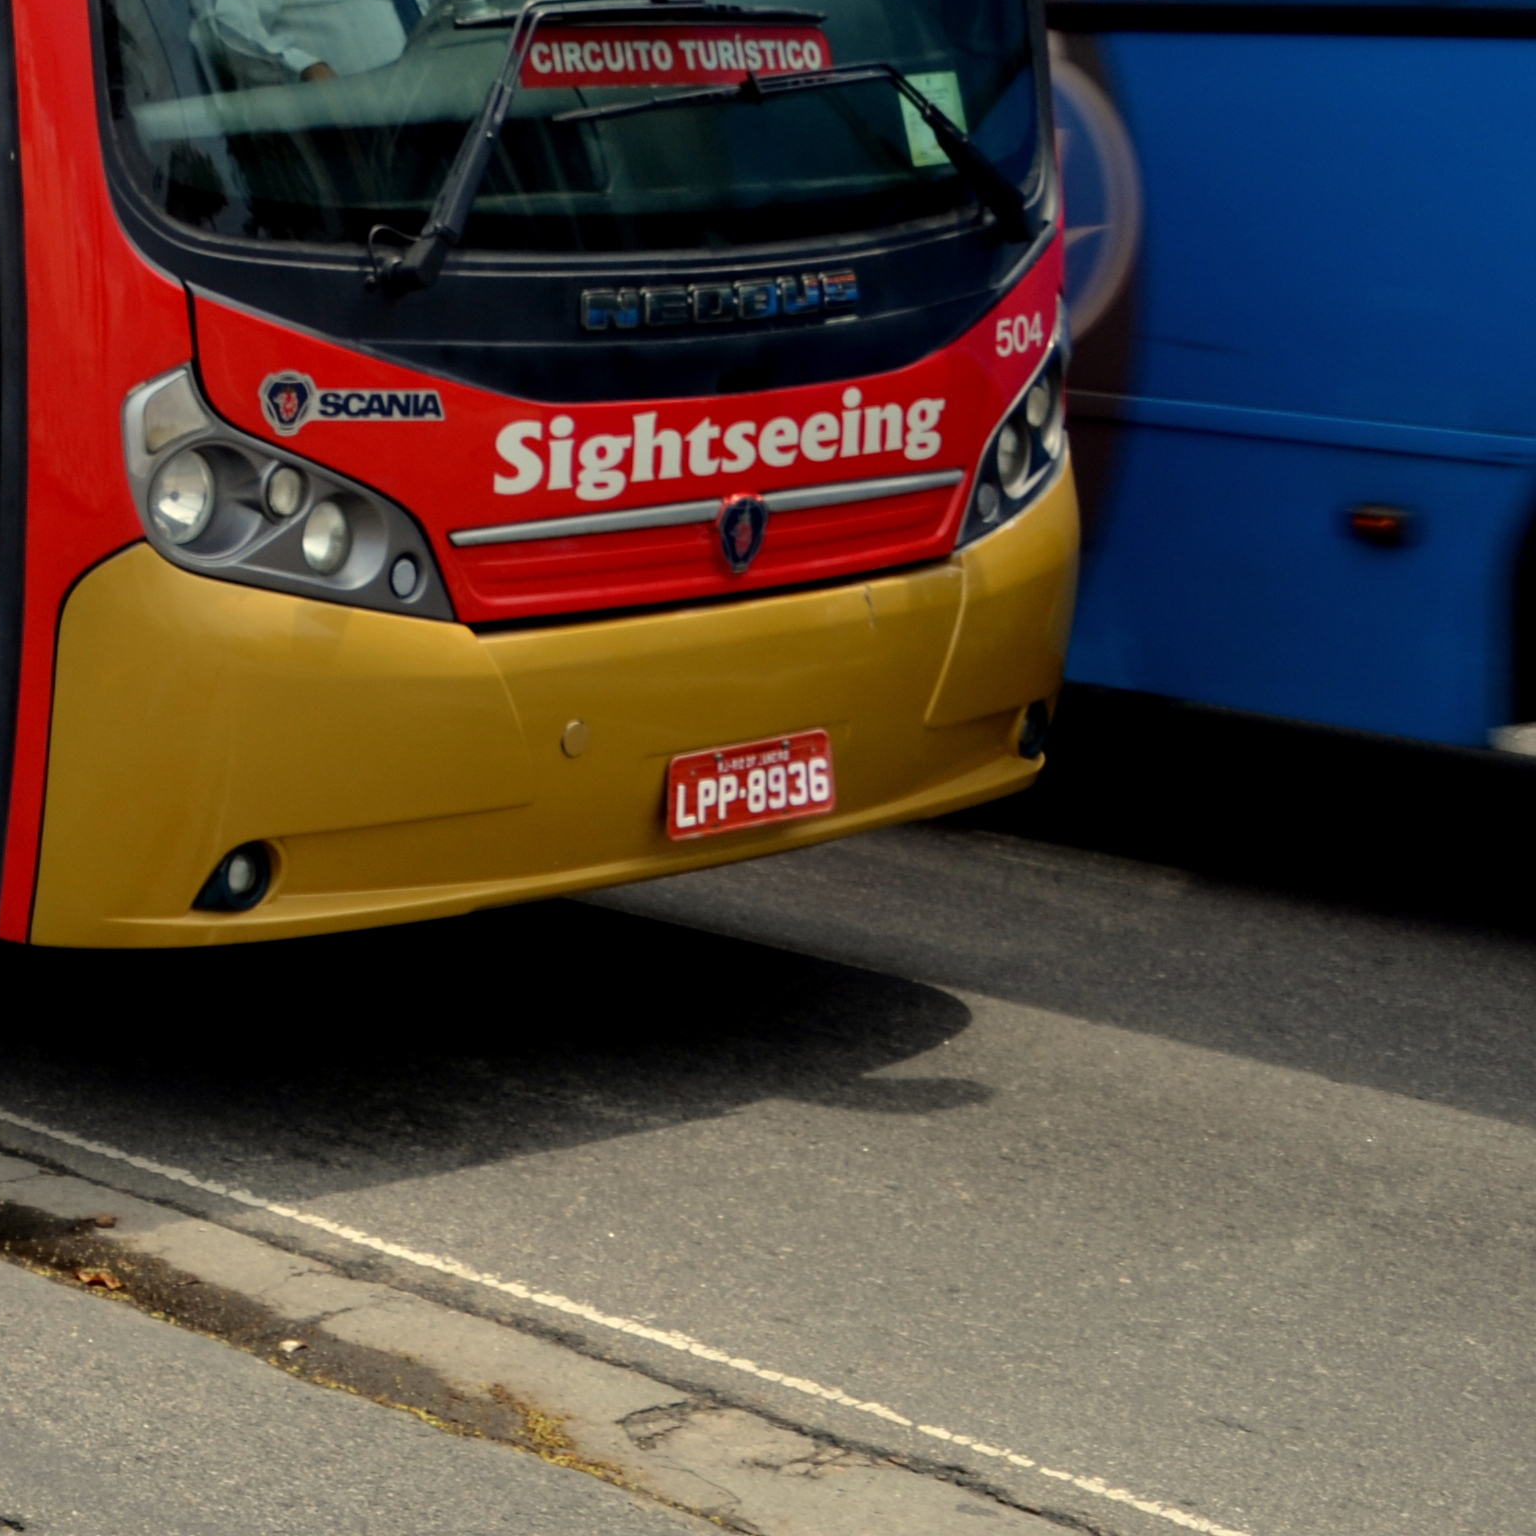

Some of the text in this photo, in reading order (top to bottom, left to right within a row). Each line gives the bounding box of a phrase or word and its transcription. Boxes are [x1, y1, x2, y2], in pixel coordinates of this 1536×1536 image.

[530, 33, 823, 74] CIRCUITO TURÍSTICO
[581, 259, 859, 331] NEOBUS
[995, 312, 1044, 357] 504
[319, 392, 442, 419] SCANIA
[494, 387, 945, 501] Sightseeing
